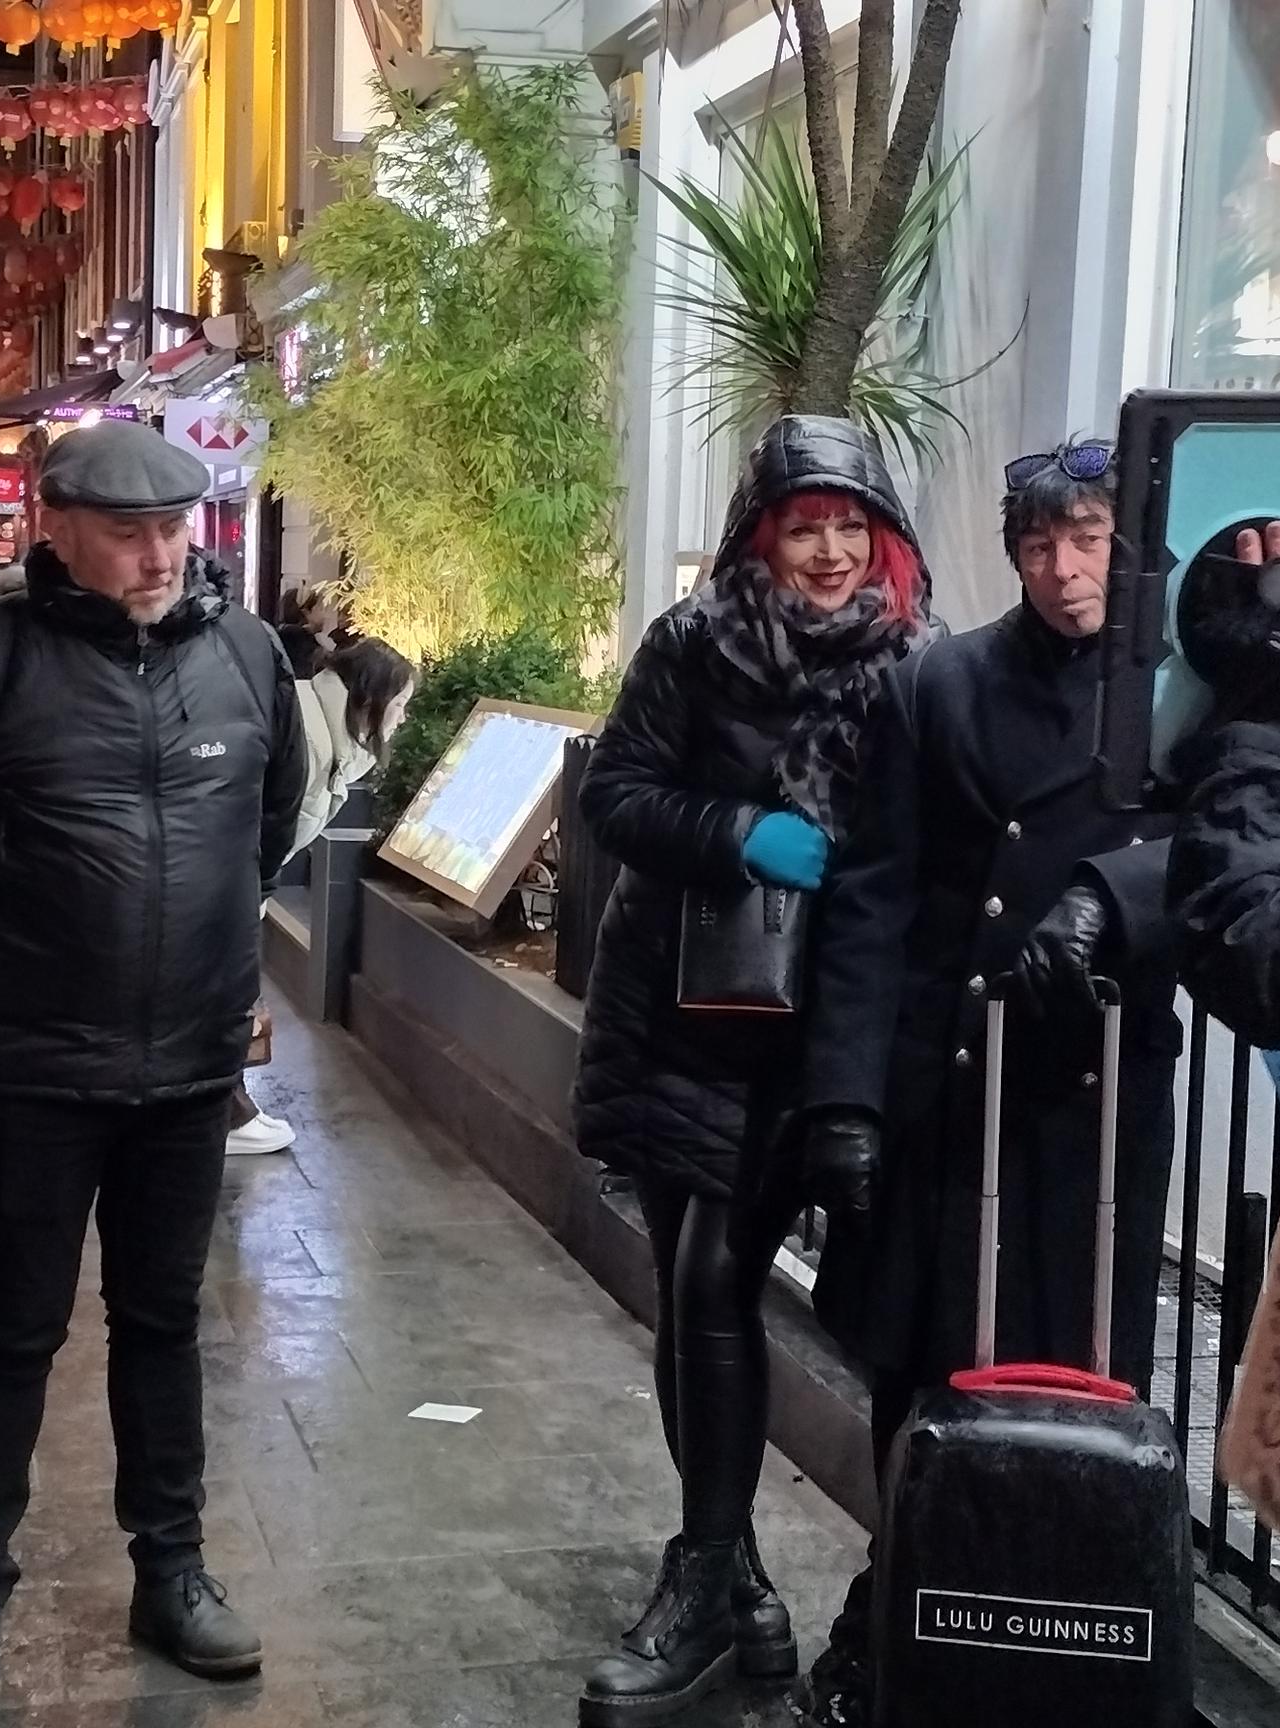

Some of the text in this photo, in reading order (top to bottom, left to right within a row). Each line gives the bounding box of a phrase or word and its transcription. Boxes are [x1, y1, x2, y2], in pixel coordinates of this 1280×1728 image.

[200, 741, 226, 758] Rab
[935, 1607, 1136, 1645] LULU GUINNESS
